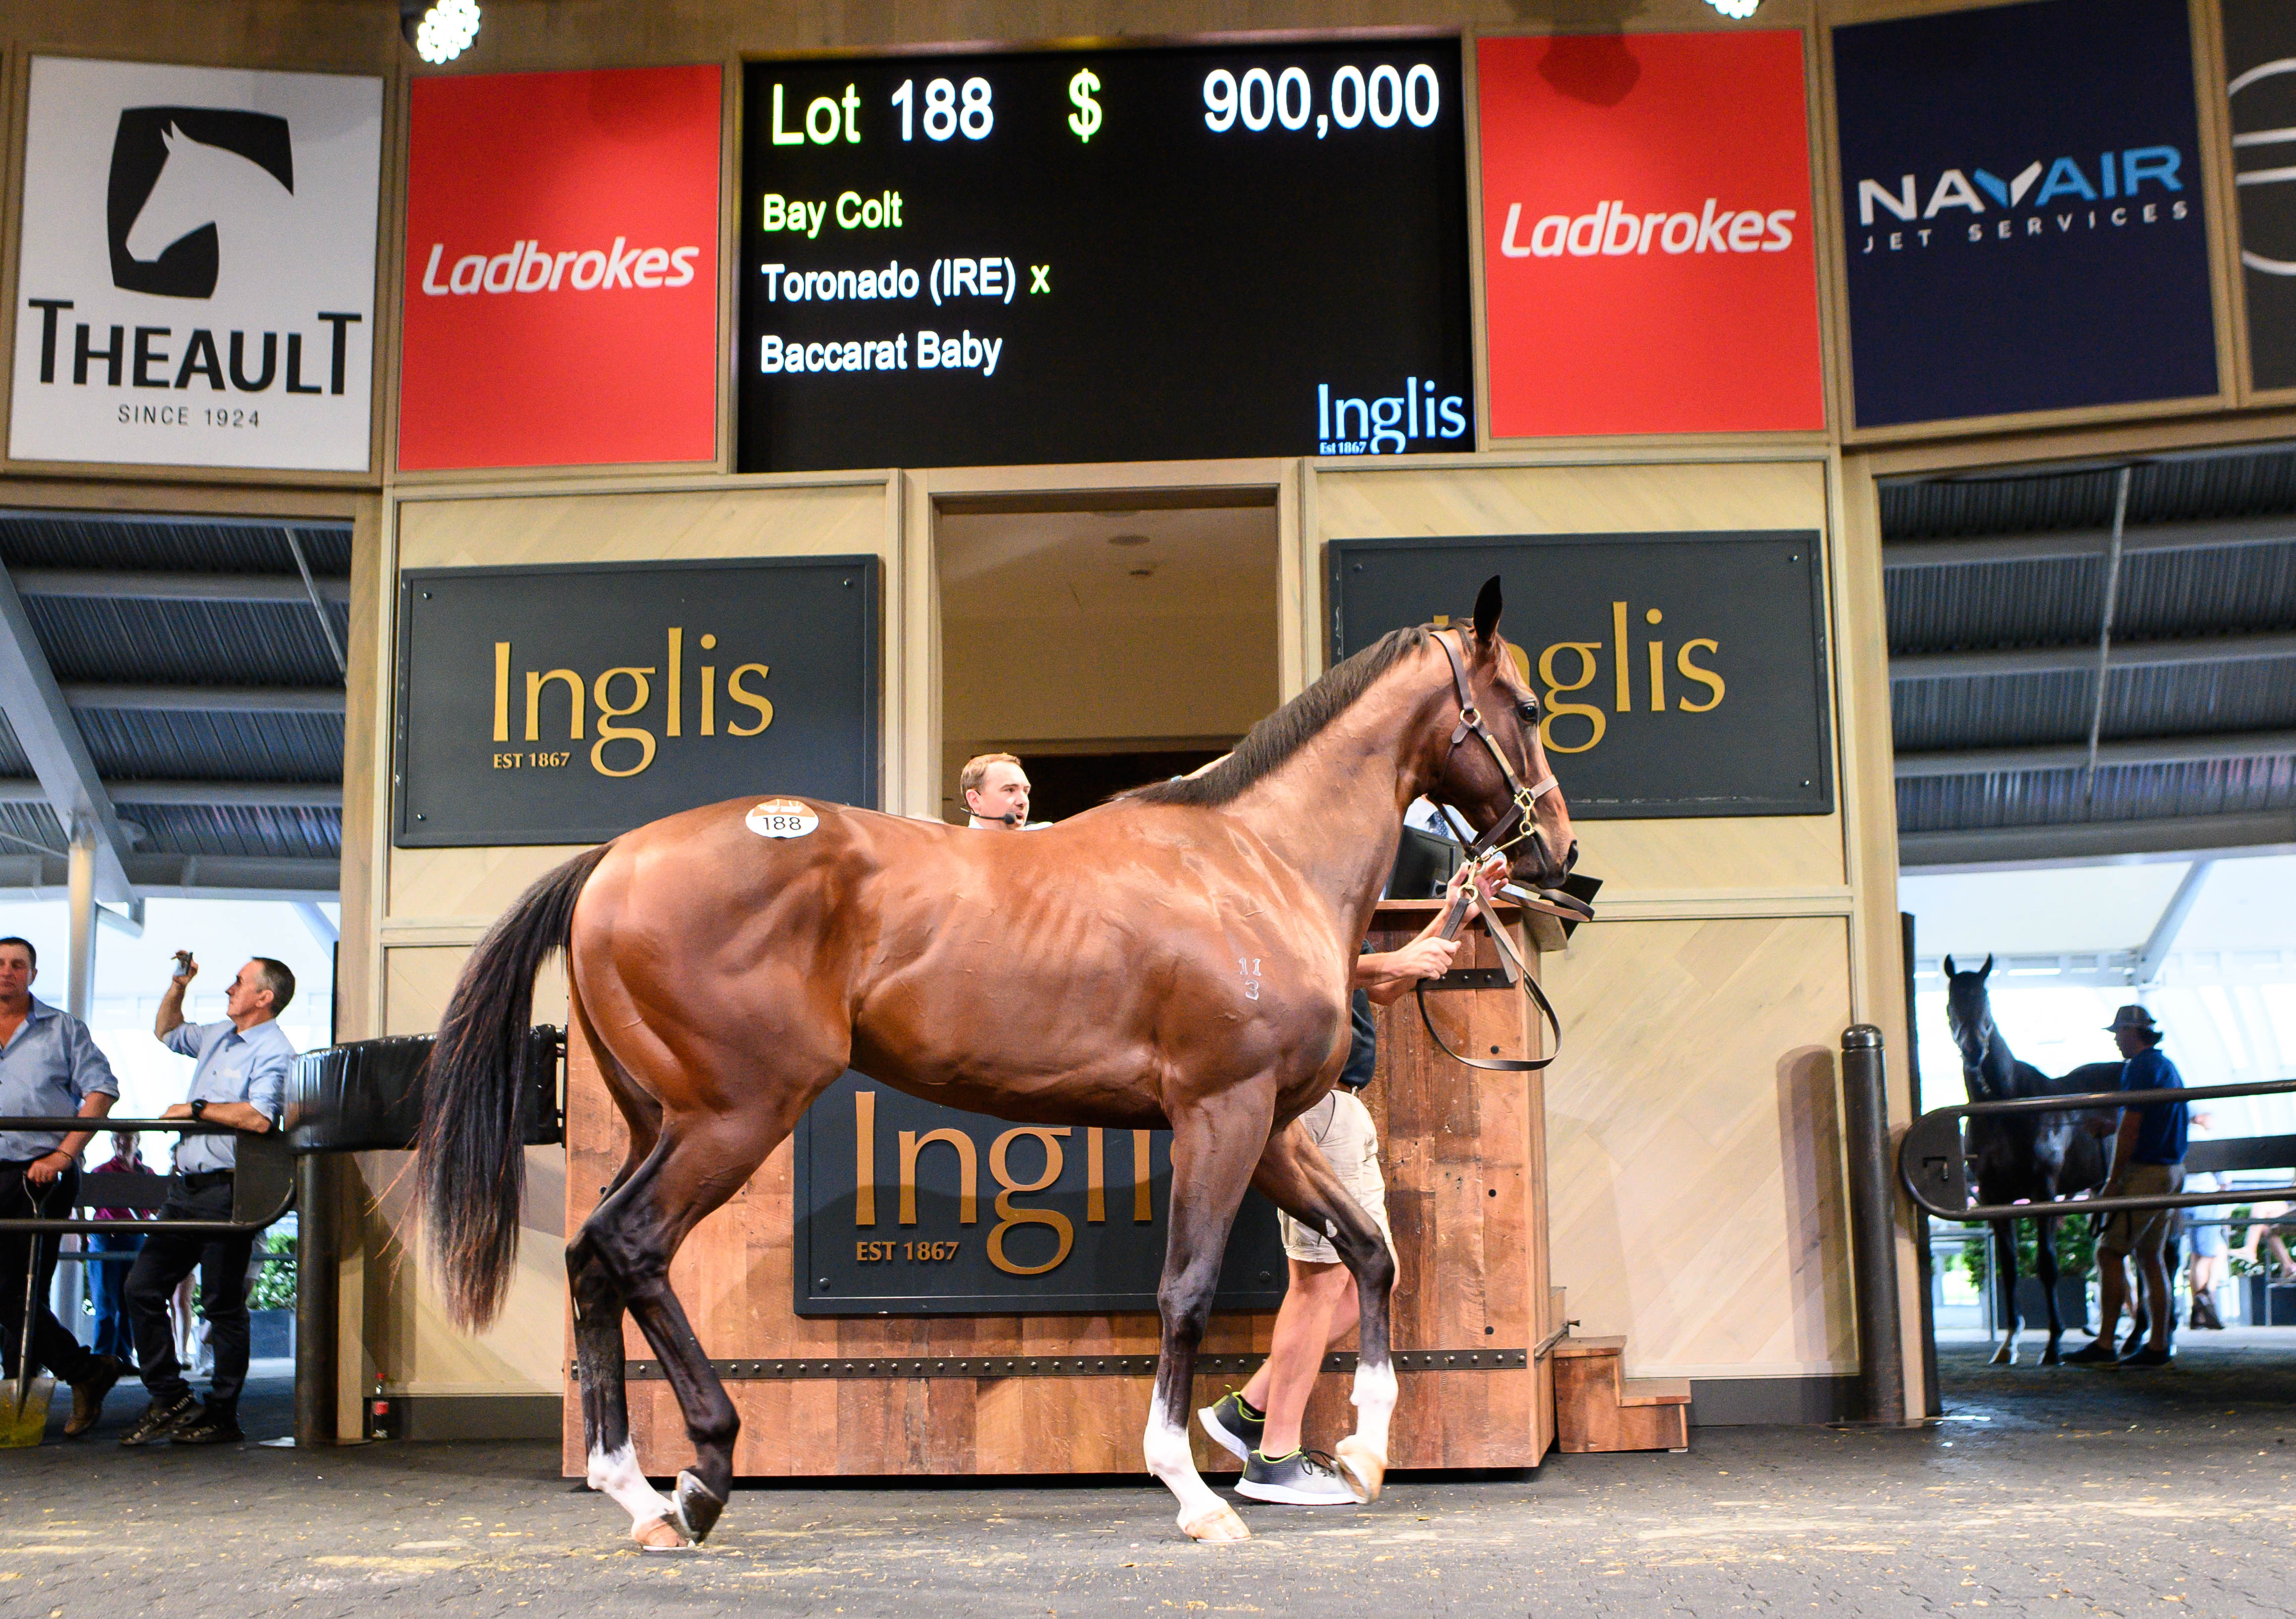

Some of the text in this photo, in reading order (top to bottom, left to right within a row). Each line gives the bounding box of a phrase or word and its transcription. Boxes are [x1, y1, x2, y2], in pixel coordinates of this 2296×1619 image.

[771, 63, 1441, 146] Lot 188 $ 900,000
[1858, 145, 2184, 226] NAVAIR
[763, 190, 904, 240] Bay Colt
[1501, 198, 1796, 258] Ladbrokes
[1862, 199, 2188, 254] JET SERVICES
[422, 236, 700, 296] Ladbrokes
[760, 257, 1051, 306] Toronado (IRE) x
[28, 298, 363, 395] THEAULT
[760, 328, 1004, 378] Baccarat Baby
[118, 403, 261, 429] SINCE 1924
[1317, 376, 1467, 454] Inglis
[1319, 441, 1367, 455] Est 1867
[492, 626, 775, 777] Inglis
[1433, 600, 1726, 754] glis
[493, 752, 571, 769] EST 1867
[763, 816, 801, 831] 188
[1245, 980, 1259, 1000] 3
[855, 1090, 1174, 1275] Ingli
[855, 1240, 959, 1262] EST 1867
